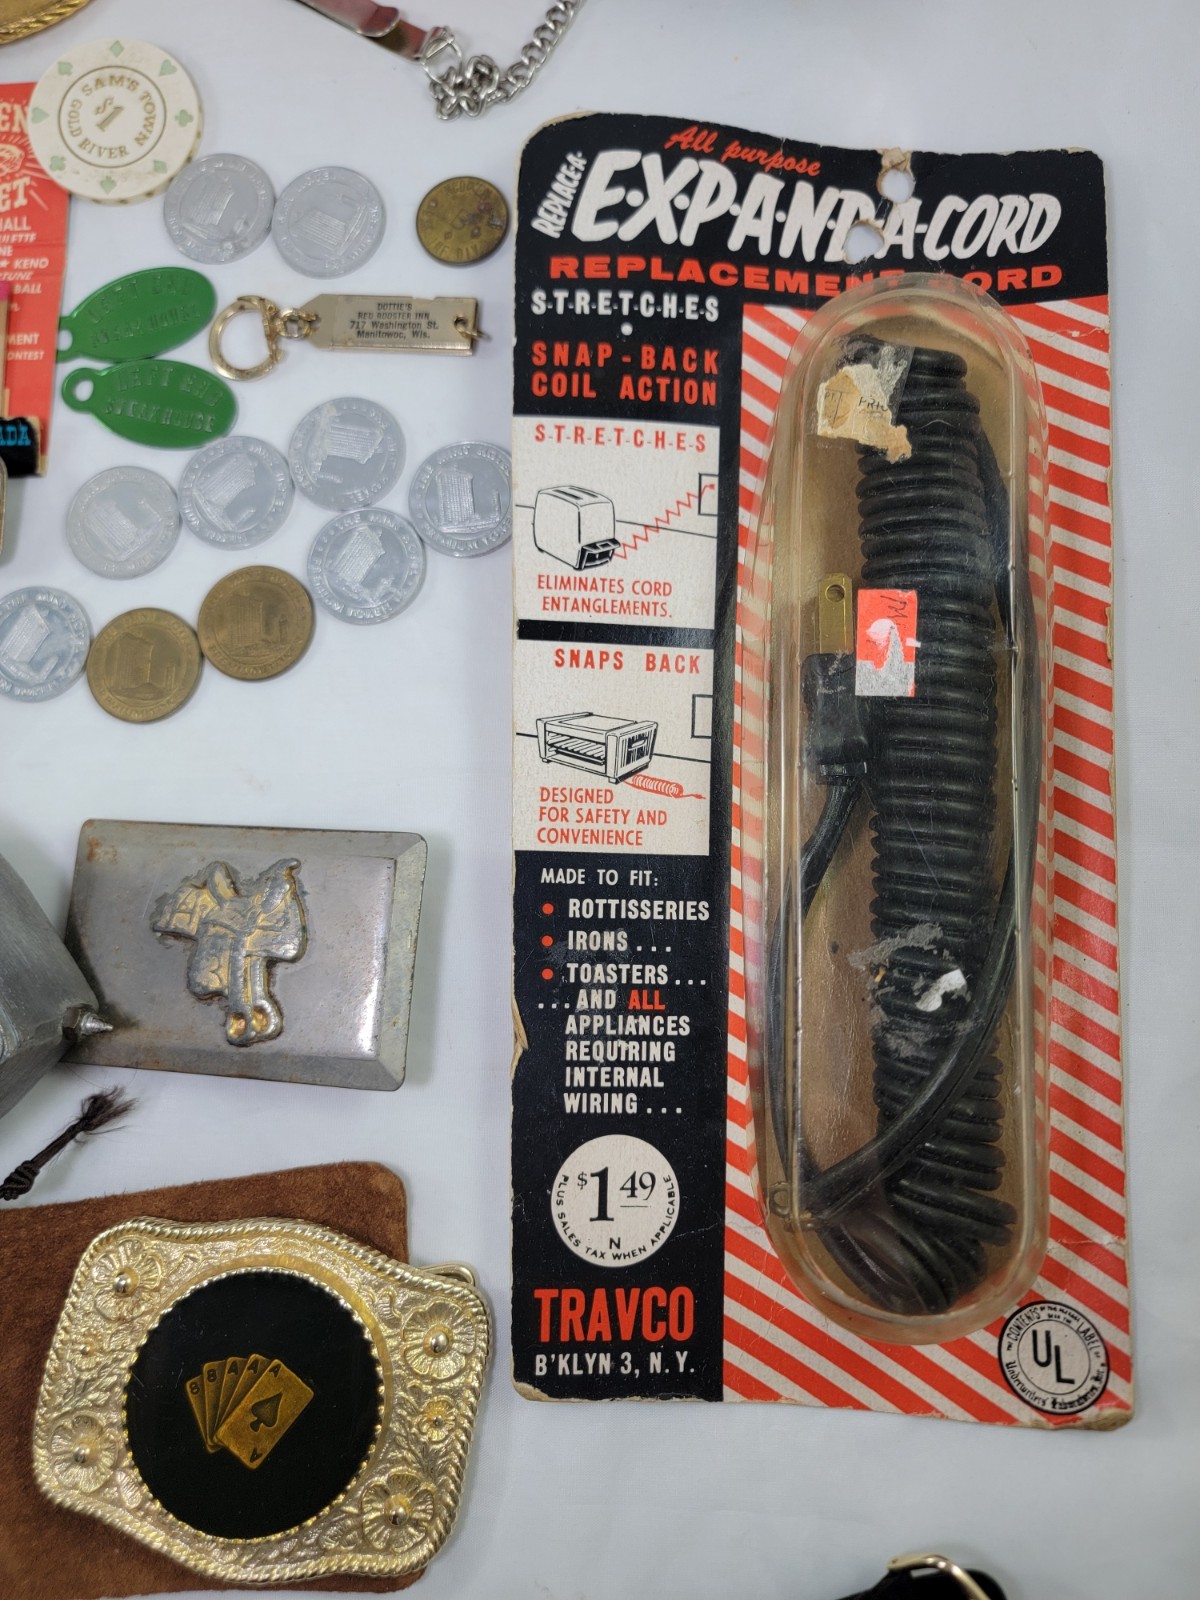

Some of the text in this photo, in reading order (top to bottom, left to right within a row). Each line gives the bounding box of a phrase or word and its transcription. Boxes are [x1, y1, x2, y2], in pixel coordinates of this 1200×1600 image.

[81, 75, 156, 147] SAM'S TOWN
[95, 96, 125, 132] $1
[67, 99, 130, 159] GOLD RIVER
[665, 125, 821, 176] All purpose
[0, 215, 31, 232] ALL
[13, 257, 49, 269] KENO
[14, 283, 42, 294] BALL
[357, 312, 430, 320] RED ROOSTER INN
[377, 302, 412, 311] DOTTIE'S
[350, 320, 439, 330] 717 Washington St.
[356, 330, 431, 340] Manitowoc, Wis.
[531, 370, 717, 406] COIL ACTION
[537, 574, 673, 597] ELIMINATES CORD
[542, 596, 673, 618] ENTANGLEMENTS.
[554, 648, 700, 674] SNAPS BACK
[539, 786, 614, 804] DESIGNED
[538, 806, 668, 826] FOR SAFETY AND
[537, 827, 643, 846] CONVENIENCE
[540, 867, 659, 887] MADE TO FIT:
[568, 898, 710, 921] ROTTISSERIES
[628, 990, 666, 1010] ALL
[565, 1014, 691, 1036] APPLIANCES
[565, 1040, 676, 1063] REQUIRING
[565, 1066, 664, 1087] INTERNAL
[556, 1174, 676, 1260] PLUS SALES TAX WHEN APPLICABLE
[609, 1237, 621, 1250] N
[533, 1286, 694, 1342] TRAVCO
[1006, 1307, 1041, 1342] CONTENTS
[1077, 1321, 1101, 1351] LABEL
[535, 1352, 611, 1376] B'KLYN
[1032, 1330, 1075, 1384] UL
[227, 1361, 239, 1375] A
[247, 1360, 259, 1375] A
[269, 1363, 281, 1378] A
